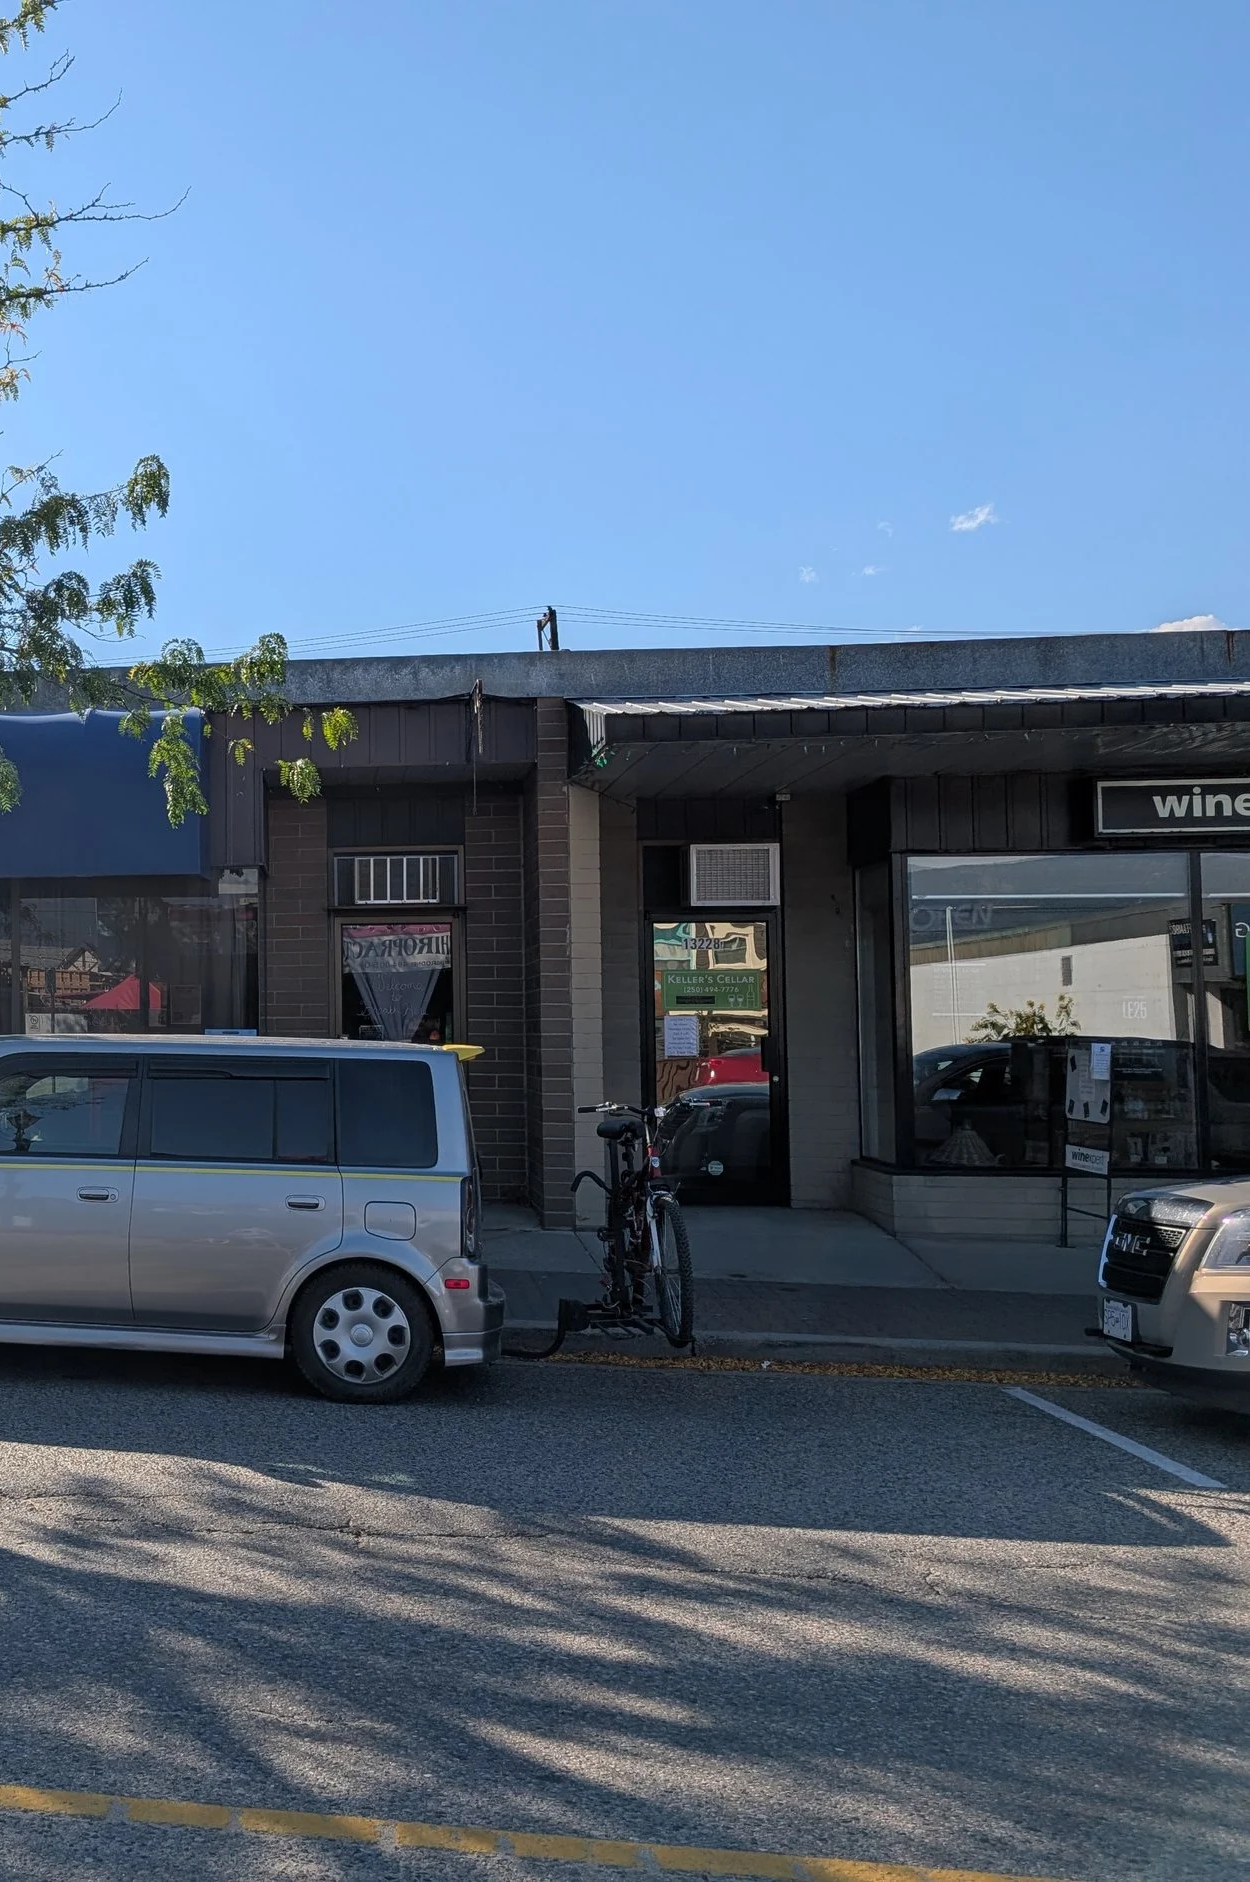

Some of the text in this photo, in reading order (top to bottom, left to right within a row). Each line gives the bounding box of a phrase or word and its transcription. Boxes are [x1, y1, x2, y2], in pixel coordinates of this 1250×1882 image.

[1152, 786, 1250, 818] wine
[668, 974, 755, 984] KELLER'S CELLAR
[683, 986, 703, 994] (250)
[1114, 1232, 1151, 1256] GMC
